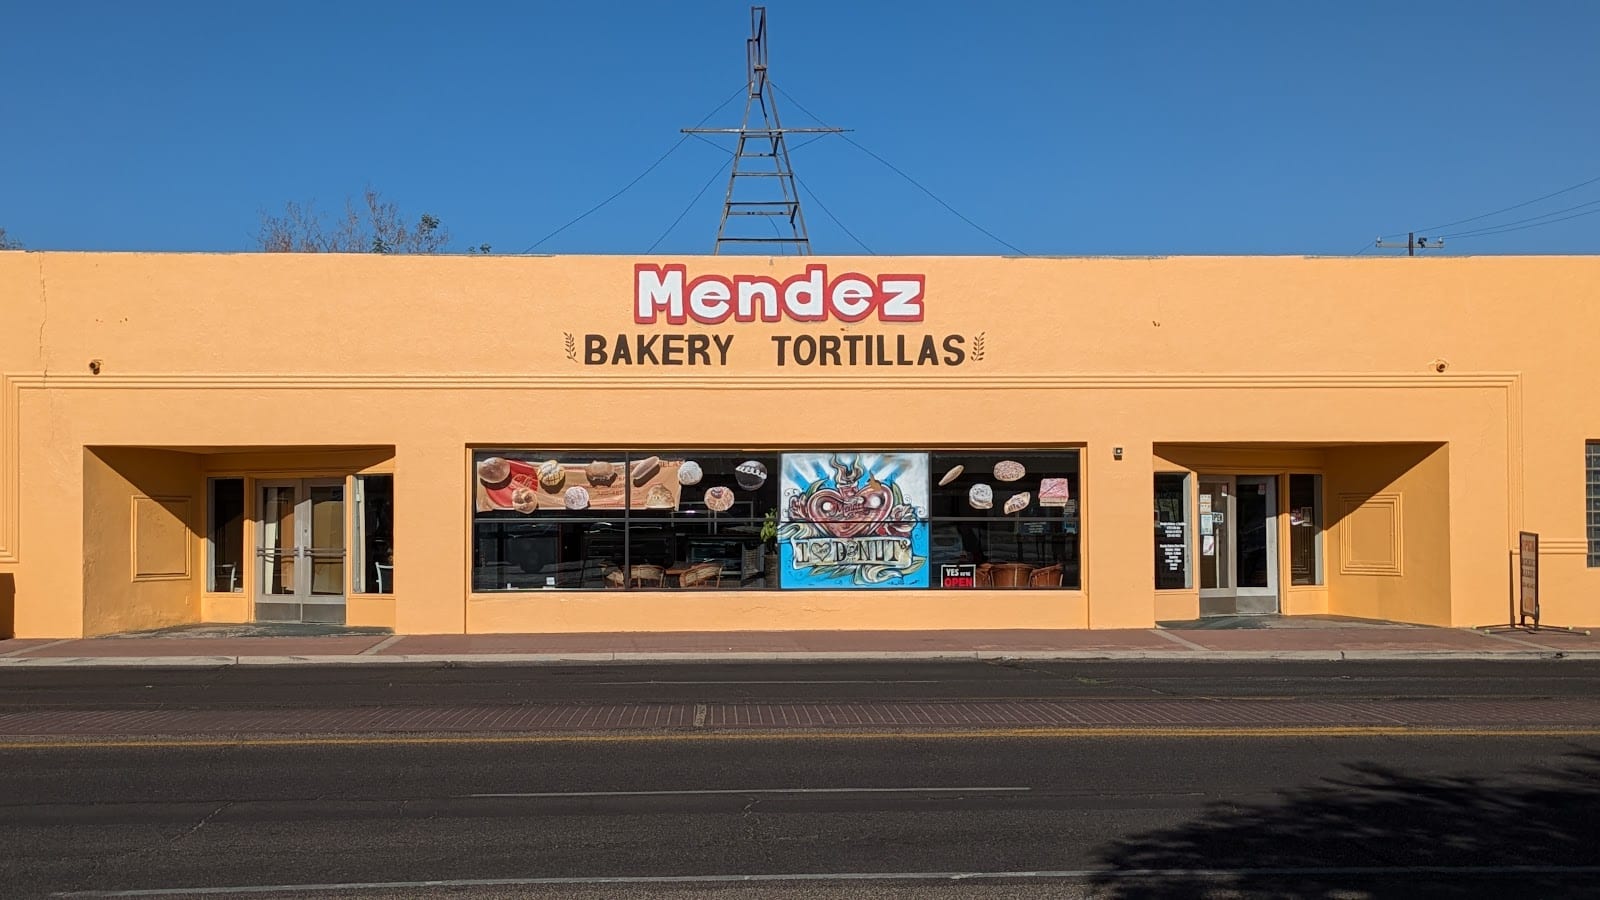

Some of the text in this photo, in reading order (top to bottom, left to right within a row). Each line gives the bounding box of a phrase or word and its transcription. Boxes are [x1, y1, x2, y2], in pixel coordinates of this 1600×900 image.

[635, 264, 925, 324] Mendez
[584, 334, 966, 366] BAKERY TORTILLAS
[796, 542, 810, 562] I
[946, 568, 959, 576] YES
[945, 578, 972, 587] OPEN
